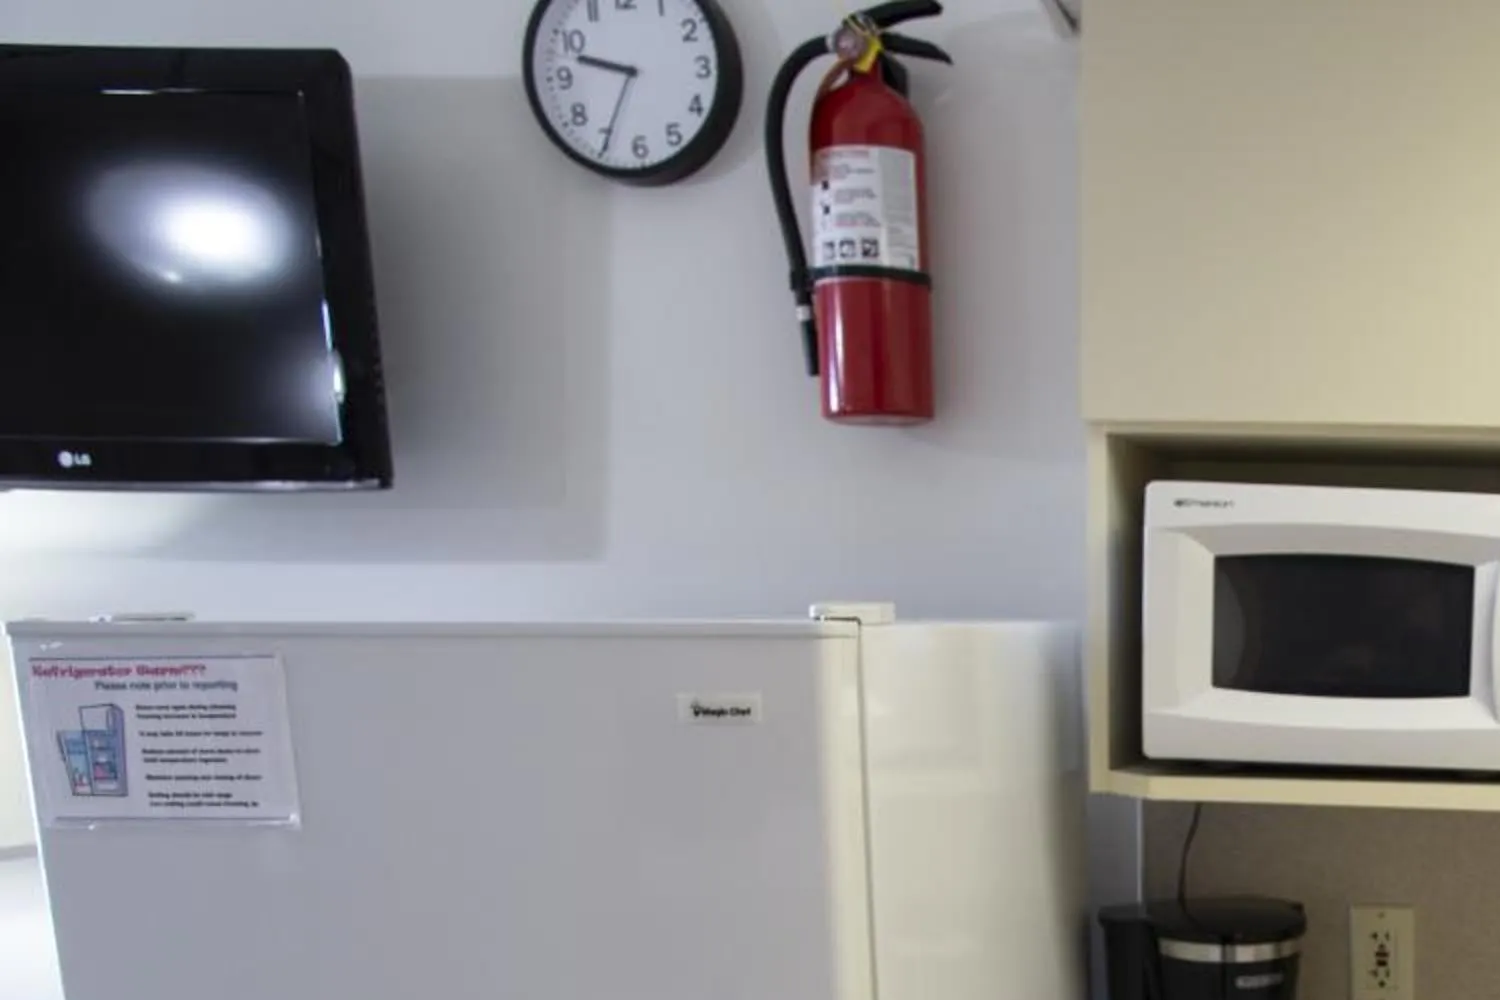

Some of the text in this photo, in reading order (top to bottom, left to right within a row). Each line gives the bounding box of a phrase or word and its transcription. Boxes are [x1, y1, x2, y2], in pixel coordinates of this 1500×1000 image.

[562, 29, 586, 54] 10
[681, 18, 699, 43] 2
[556, 65, 574, 91] 9
[694, 55, 712, 80] 3
[570, 102, 589, 127] 8
[688, 94, 704, 118] 4
[598, 127, 614, 153] 7
[631, 134, 650, 160] 6
[665, 122, 683, 147] 5
